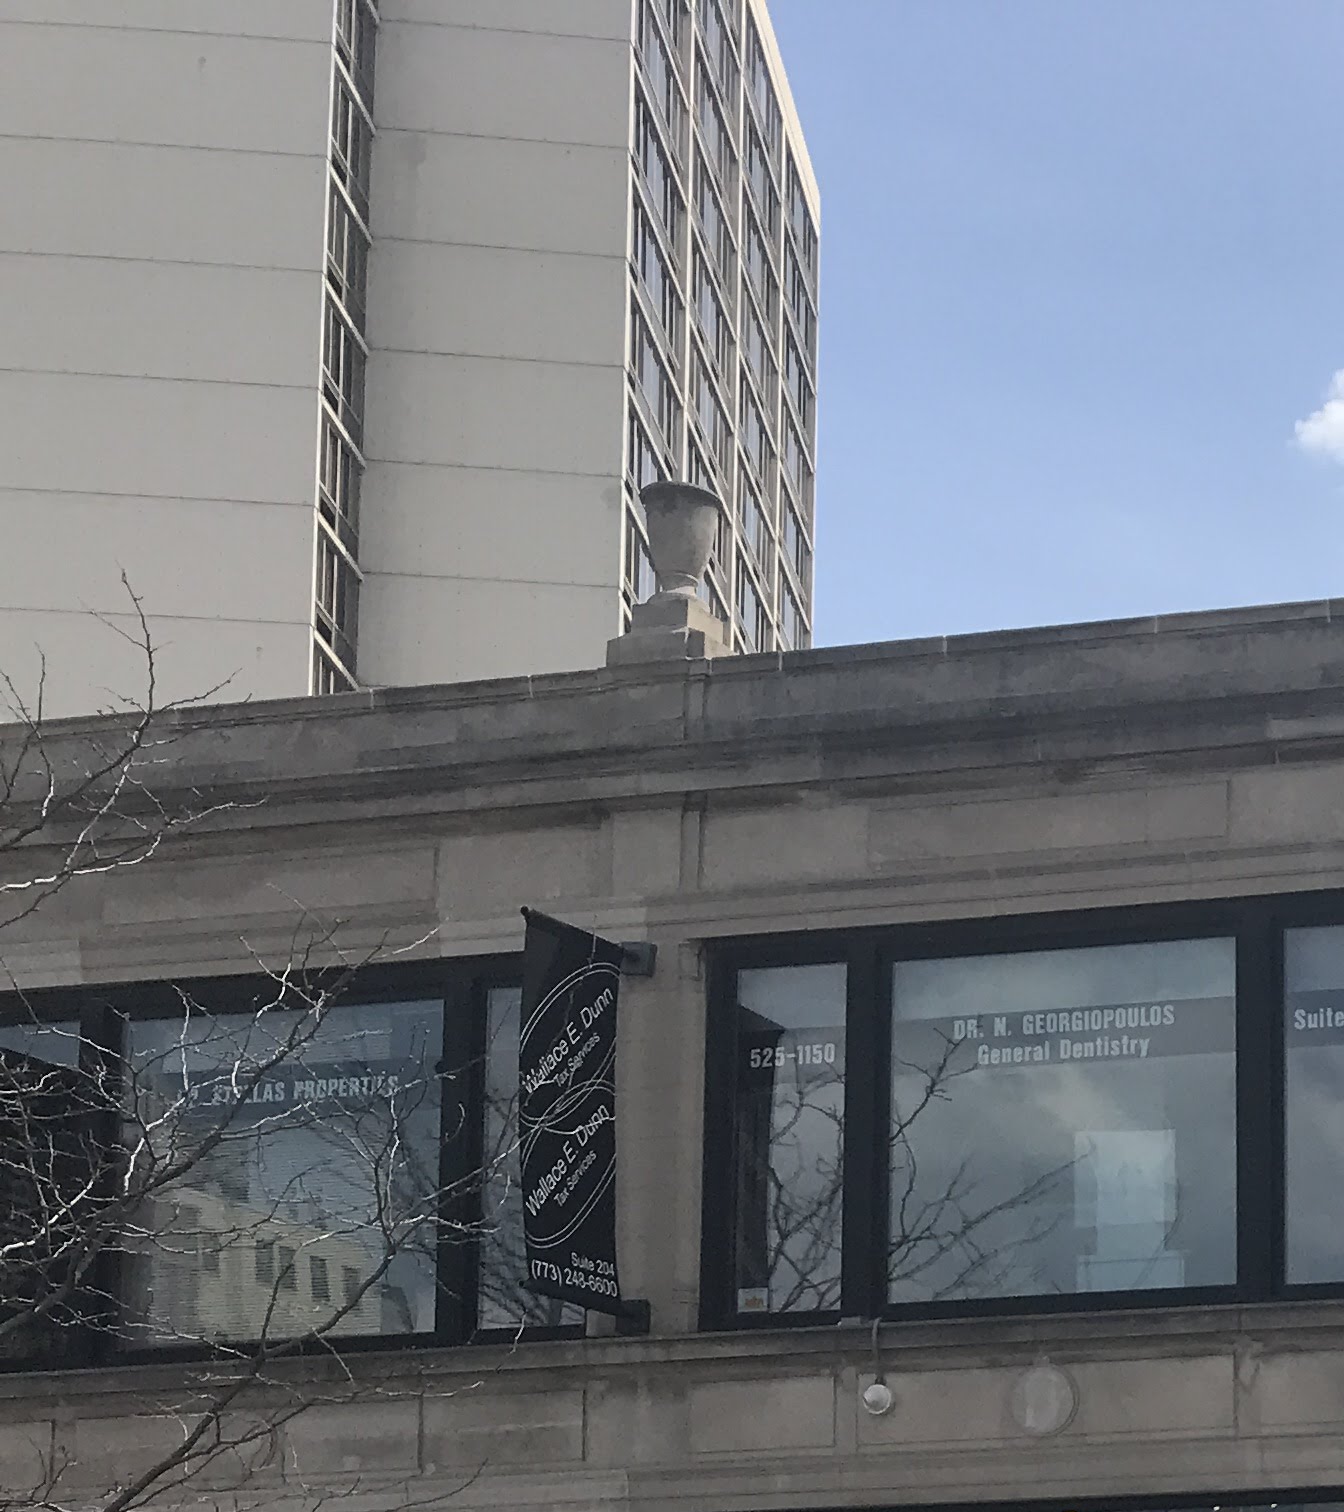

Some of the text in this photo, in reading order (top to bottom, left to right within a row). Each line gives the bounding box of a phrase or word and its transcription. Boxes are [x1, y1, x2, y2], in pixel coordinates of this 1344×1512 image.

[566, 1021, 583, 1045] E.
[580, 988, 614, 1029] Dunn
[953, 1018, 984, 1040] DR.
[1022, 1004, 1175, 1036] GEORGIOPOULOS
[1294, 1008, 1344, 1030] Suite
[750, 1043, 835, 1068] 525-1150
[977, 1035, 1150, 1066] General Dentistry
[525, 1104, 610, 1217] Wallace E. Dunn
[554, 1150, 597, 1208] Tax Services
[531, 1259, 562, 1287] (773)
[571, 1252, 615, 1276] Suite 204
